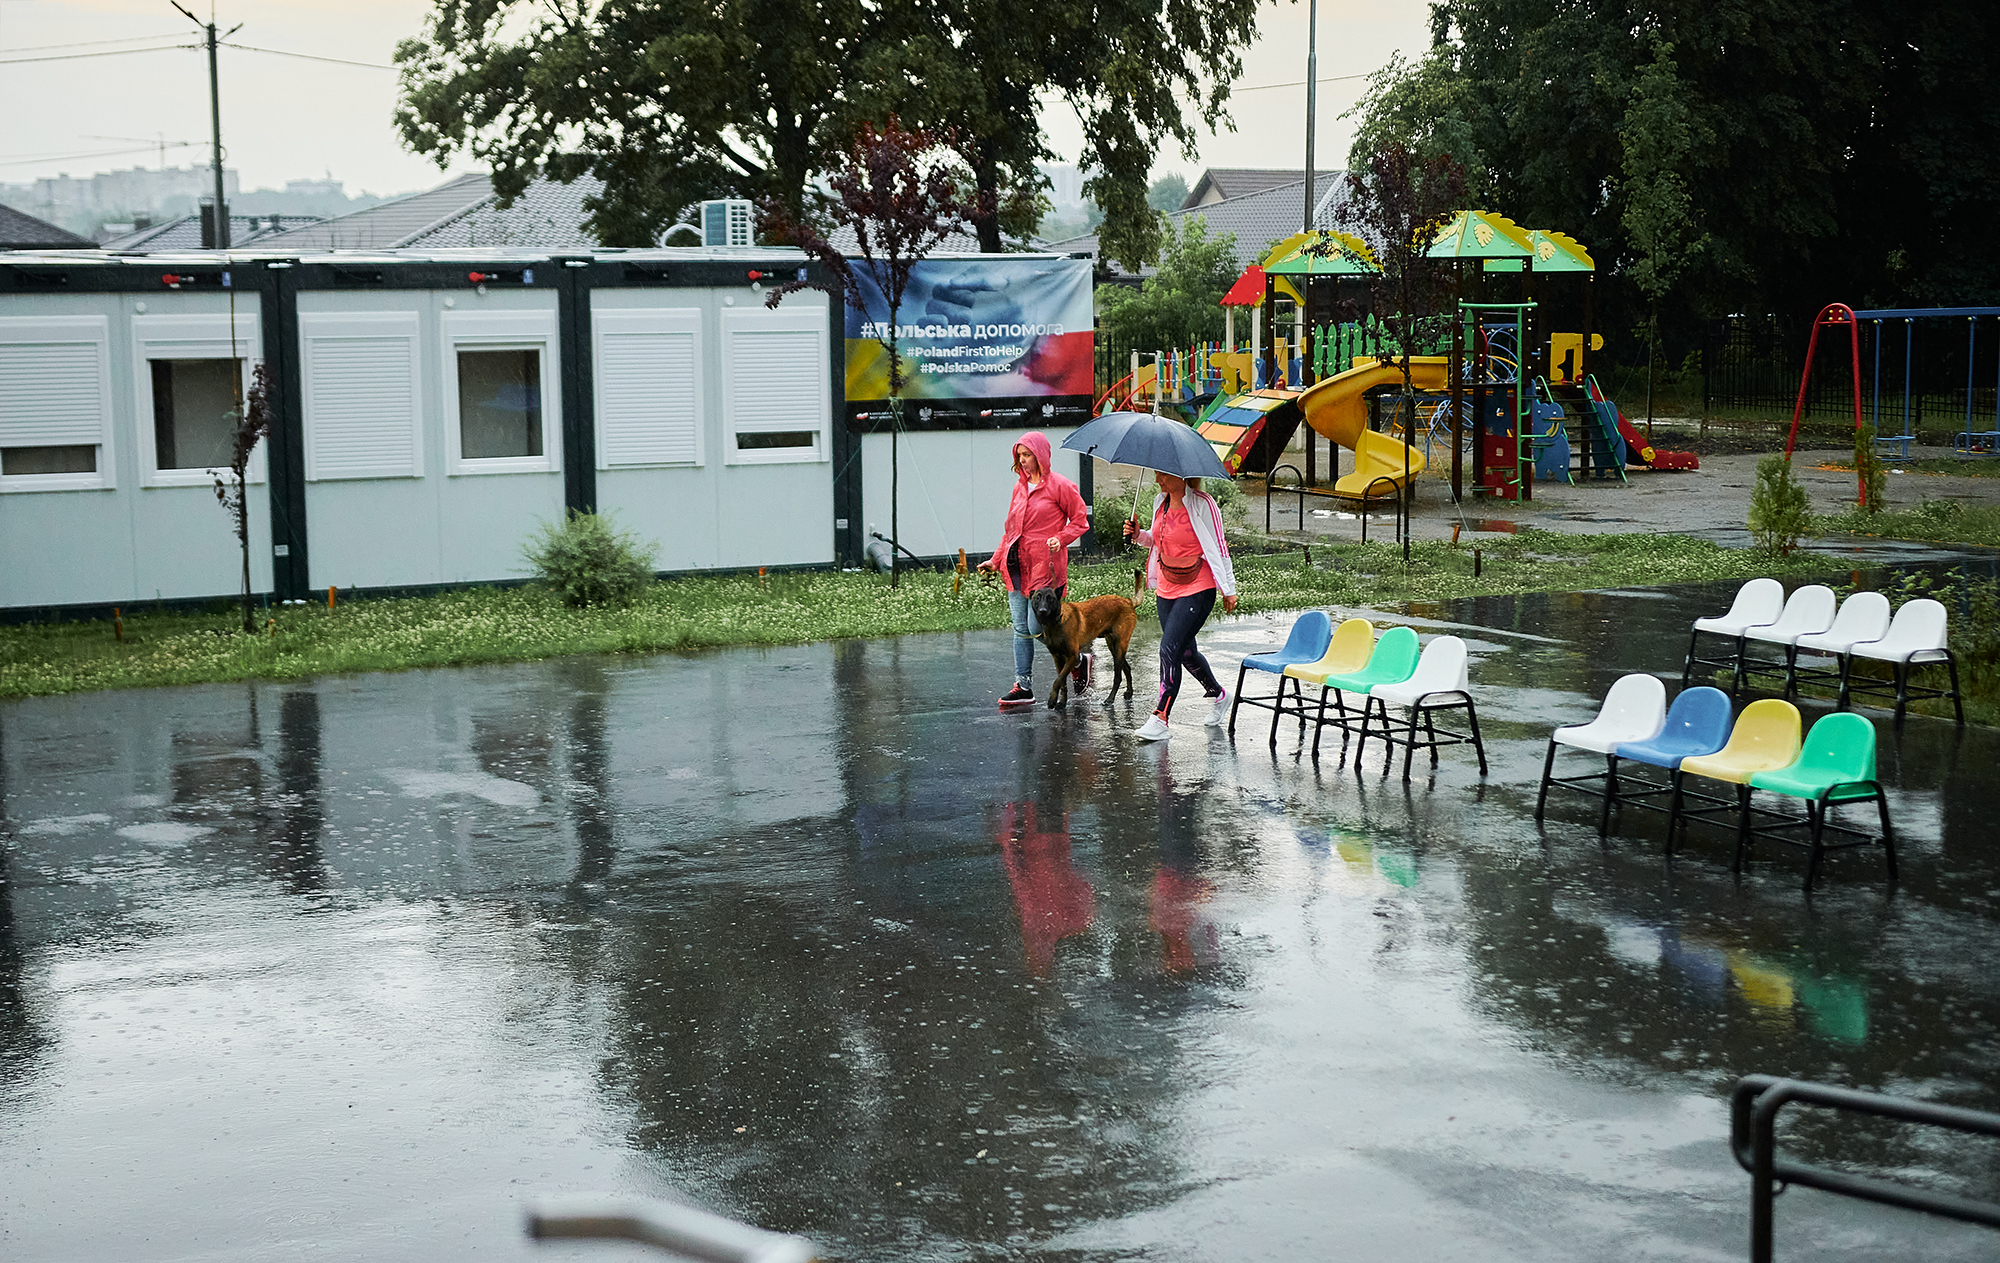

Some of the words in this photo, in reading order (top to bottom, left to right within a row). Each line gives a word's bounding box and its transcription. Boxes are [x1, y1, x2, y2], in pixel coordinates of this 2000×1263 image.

[974, 323, 1064, 339] допомога
[906, 345, 1023, 358] #PolandFirstToHelp
[920, 362, 1011, 374] #PolskaPomoc
